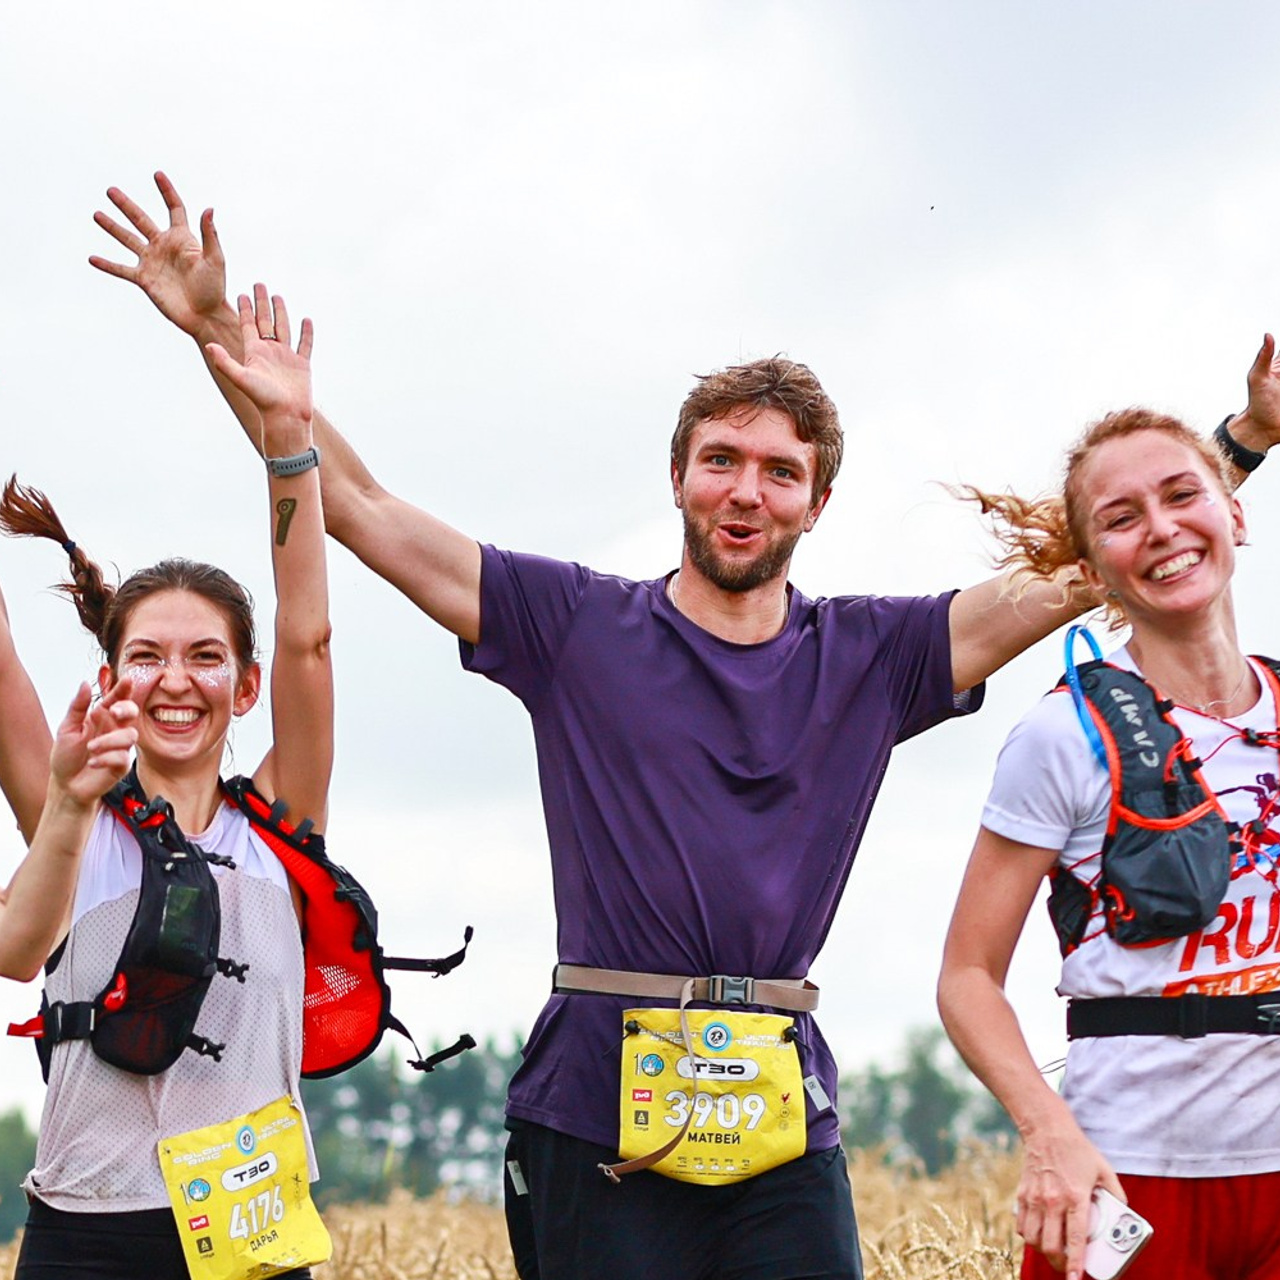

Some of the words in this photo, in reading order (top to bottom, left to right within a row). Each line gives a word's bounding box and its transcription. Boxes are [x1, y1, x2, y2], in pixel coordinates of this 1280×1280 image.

[1109, 687, 1160, 768] CAMP
[1178, 890, 1280, 973] RU
[690, 1063, 746, 1076] T30
[663, 1089, 766, 1131] 3909
[687, 1131, 741, 1145] МАТВЕЙ
[233, 1160, 271, 1182] T30
[229, 1184, 286, 1240] 4176
[249, 1229, 280, 1252] ДАРЬЯ
